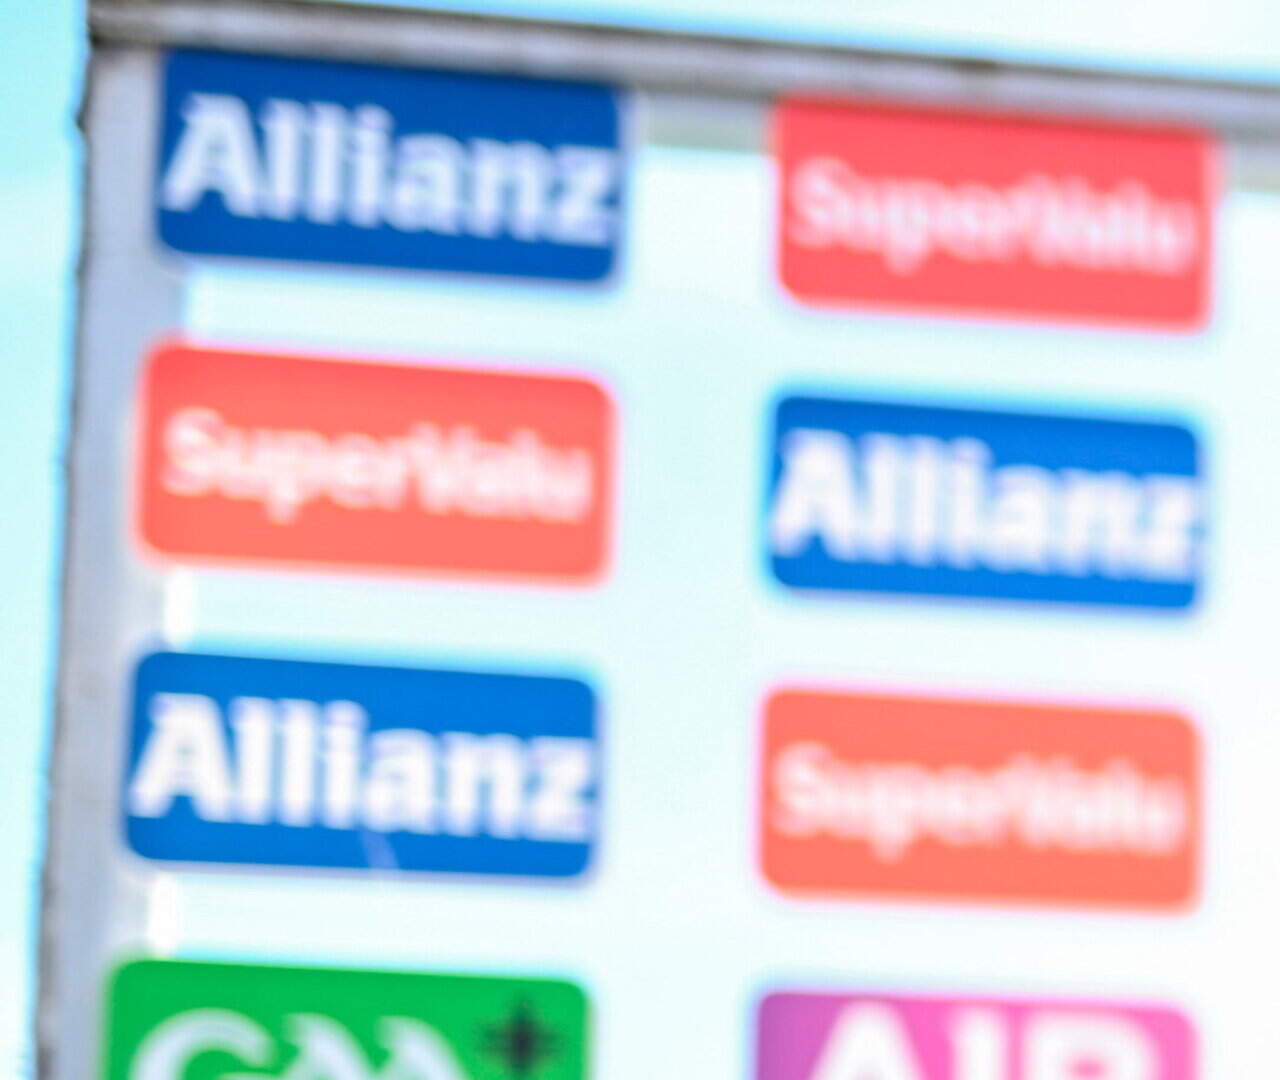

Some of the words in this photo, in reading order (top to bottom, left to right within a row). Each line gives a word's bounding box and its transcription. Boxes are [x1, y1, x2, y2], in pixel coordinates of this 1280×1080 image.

[162, 92, 618, 245] Allianz
[160, 406, 594, 522] SuperValu
[770, 428, 1204, 582] Allianz
[132, 690, 596, 846] Allianz
